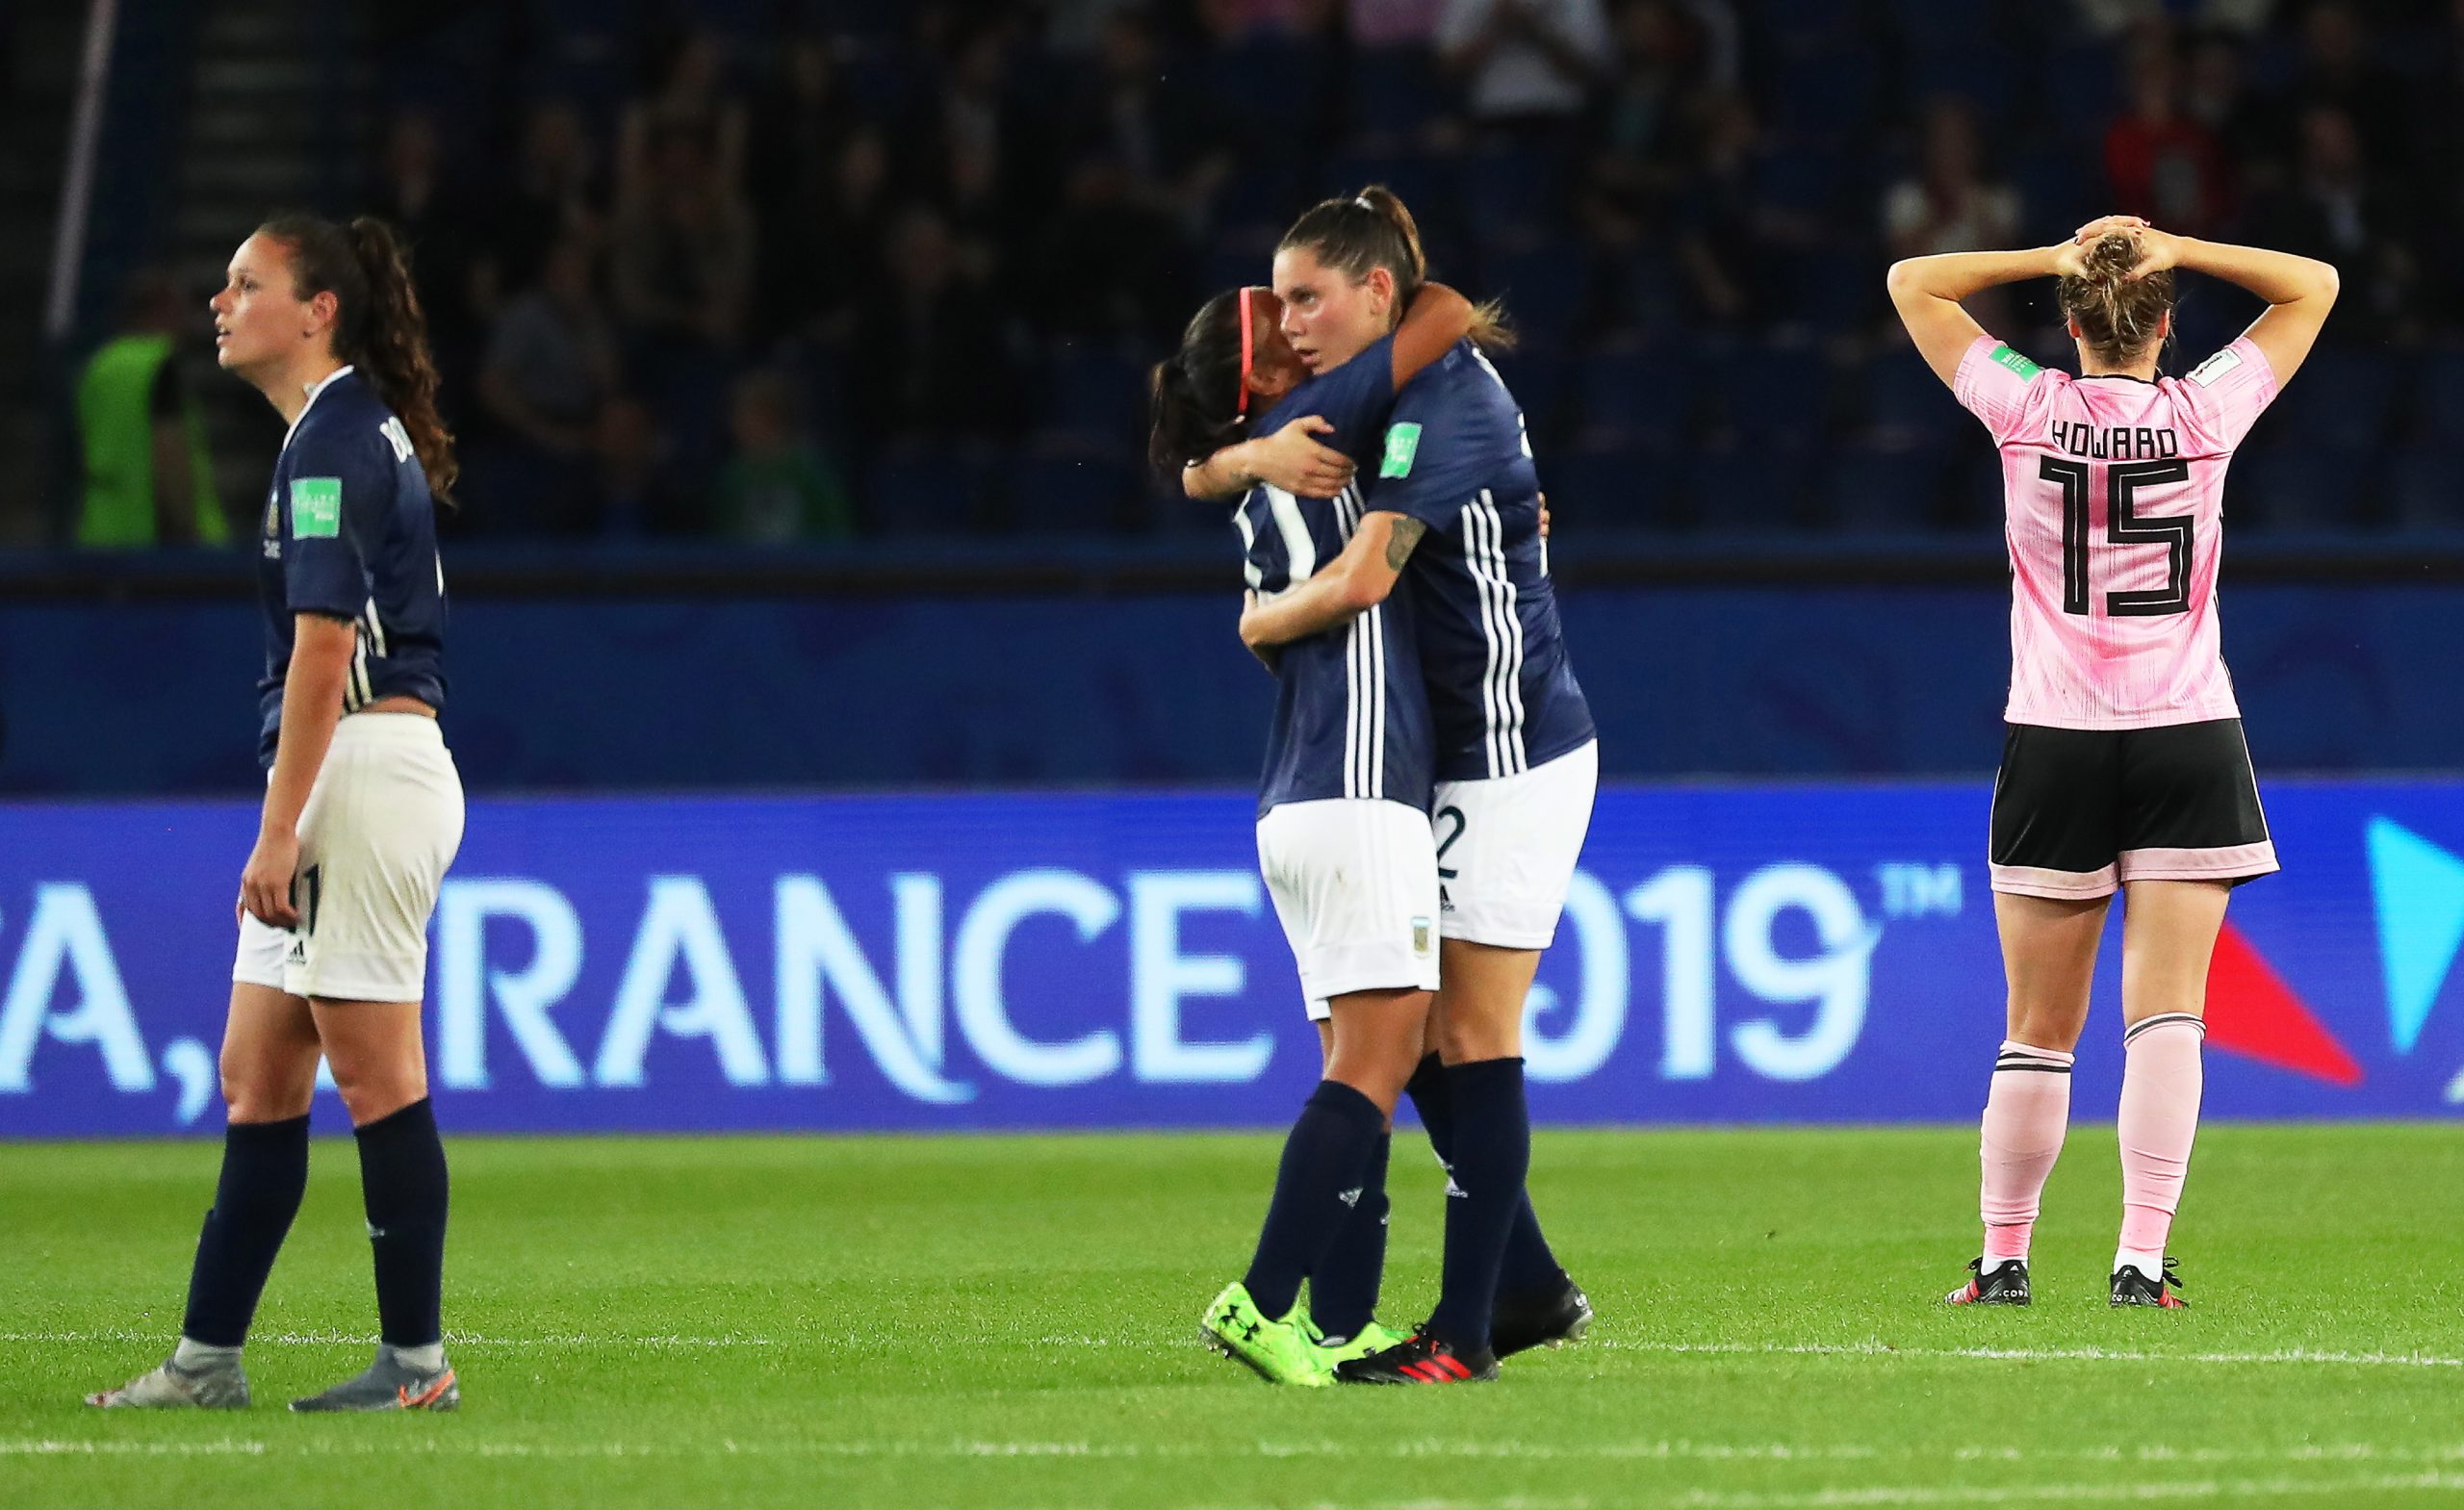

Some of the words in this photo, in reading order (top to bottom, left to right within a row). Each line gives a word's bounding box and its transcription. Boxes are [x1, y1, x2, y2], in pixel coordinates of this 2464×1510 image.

[2052, 420, 2179, 460] HOWARD
[2039, 453, 2194, 617] 15
[316, 868, 1276, 1104] RANCE
[1521, 861, 1885, 1084] 019
